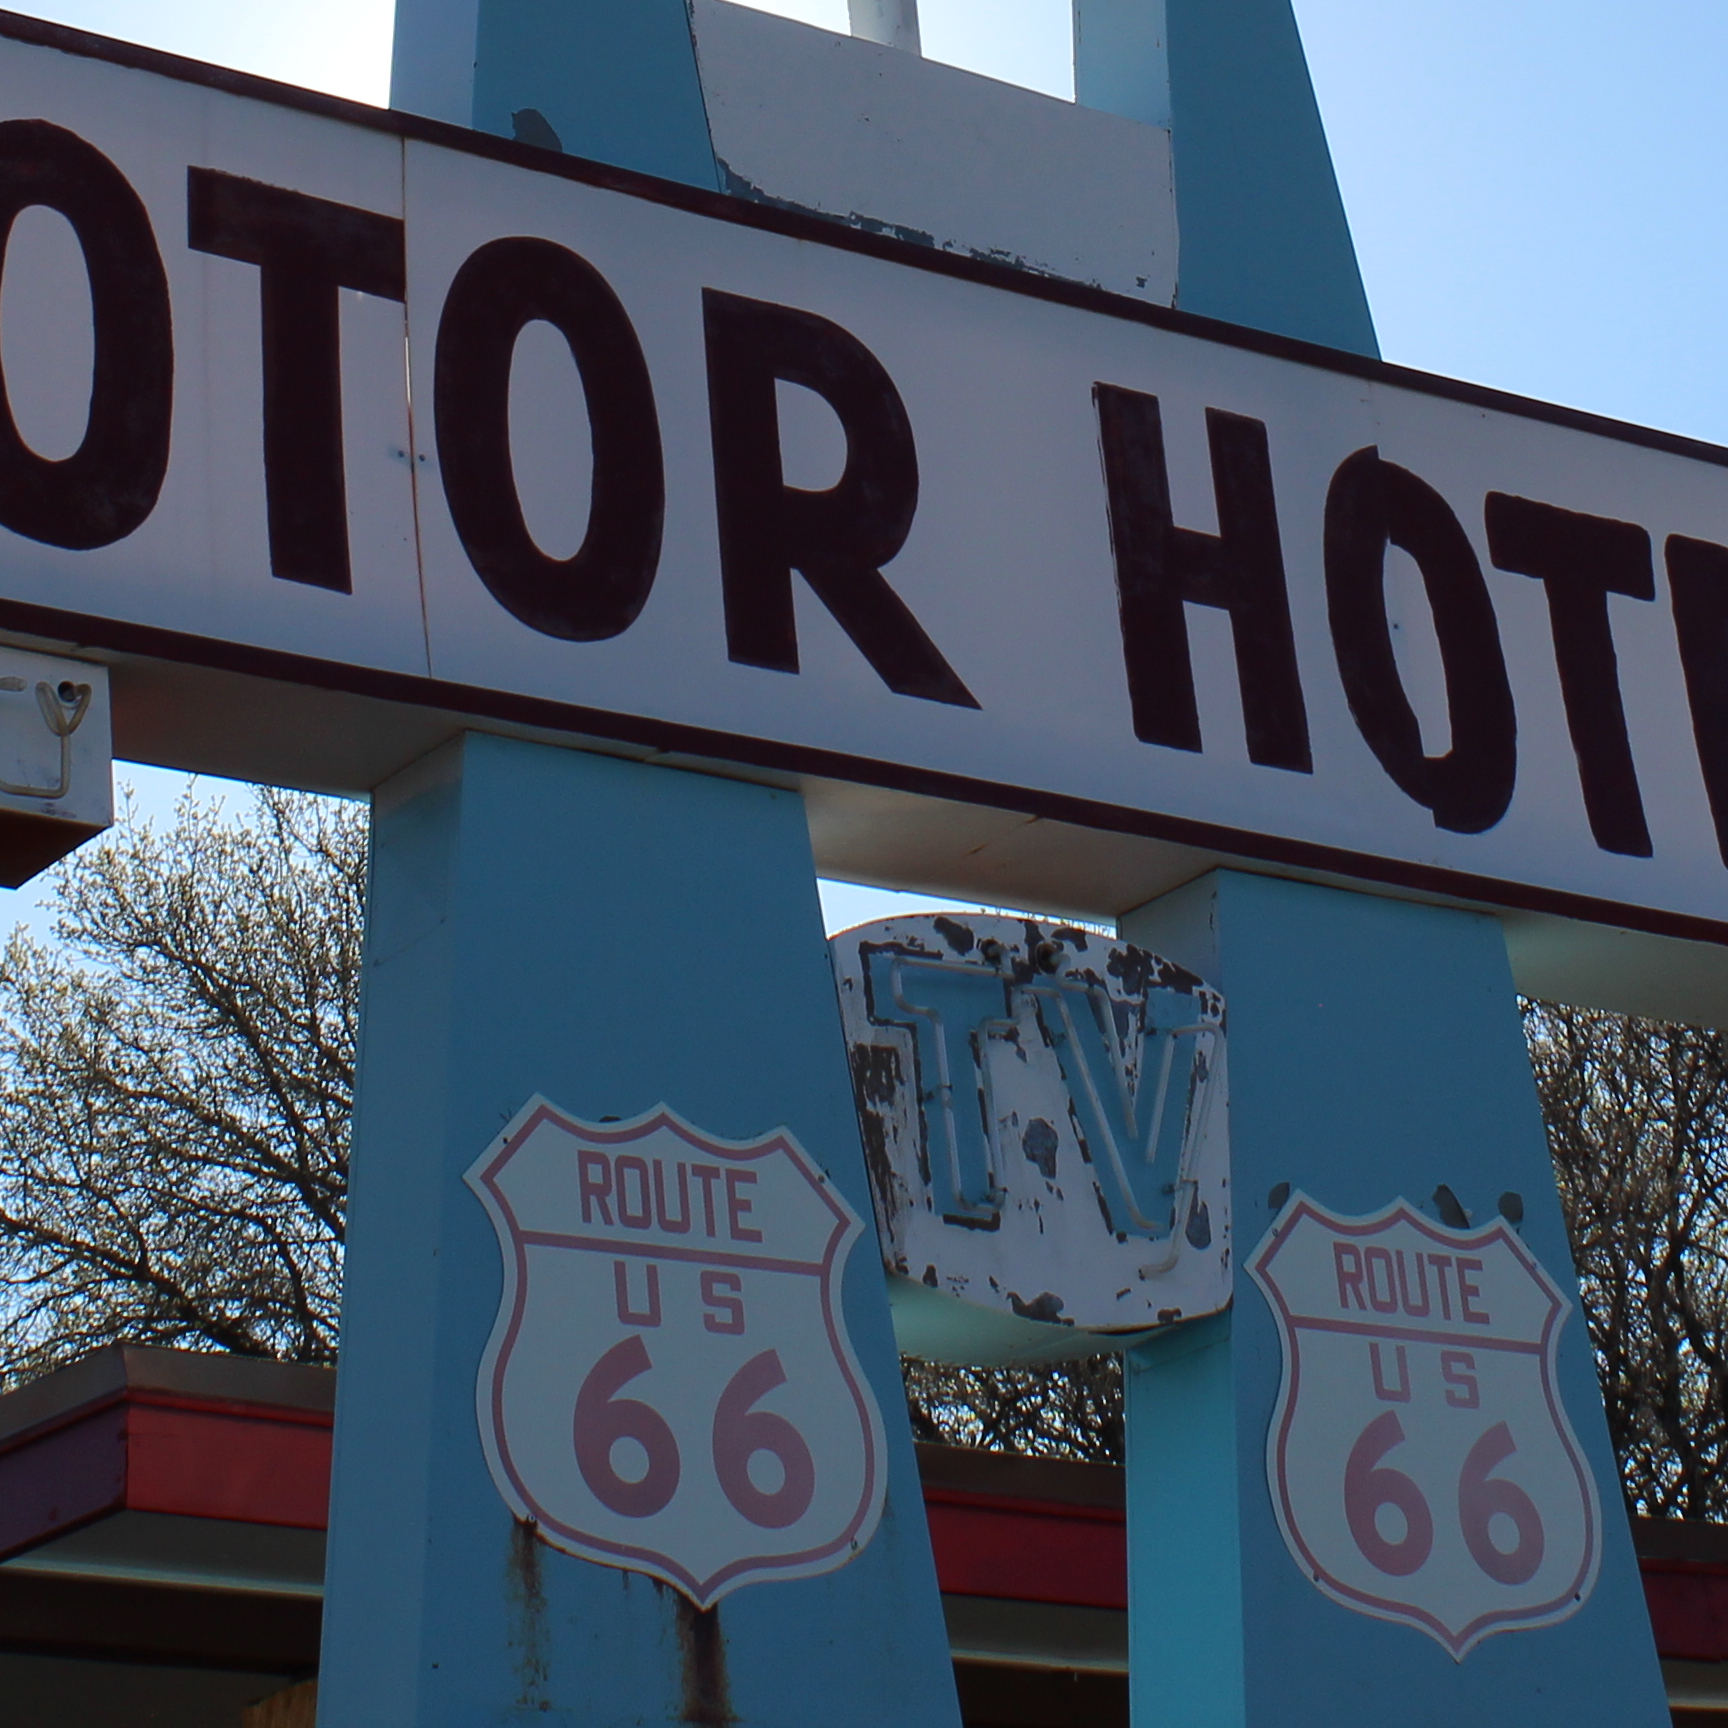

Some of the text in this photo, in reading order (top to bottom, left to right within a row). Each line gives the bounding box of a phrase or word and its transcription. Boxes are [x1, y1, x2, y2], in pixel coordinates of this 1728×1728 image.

[860, 942, 1227, 1239] TV
[576, 1150, 764, 1244] ROUTE
[1332, 1242, 1490, 1325] ROUTE
[573, 1334, 815, 1528] 66
[1344, 1408, 1544, 1585] 66
